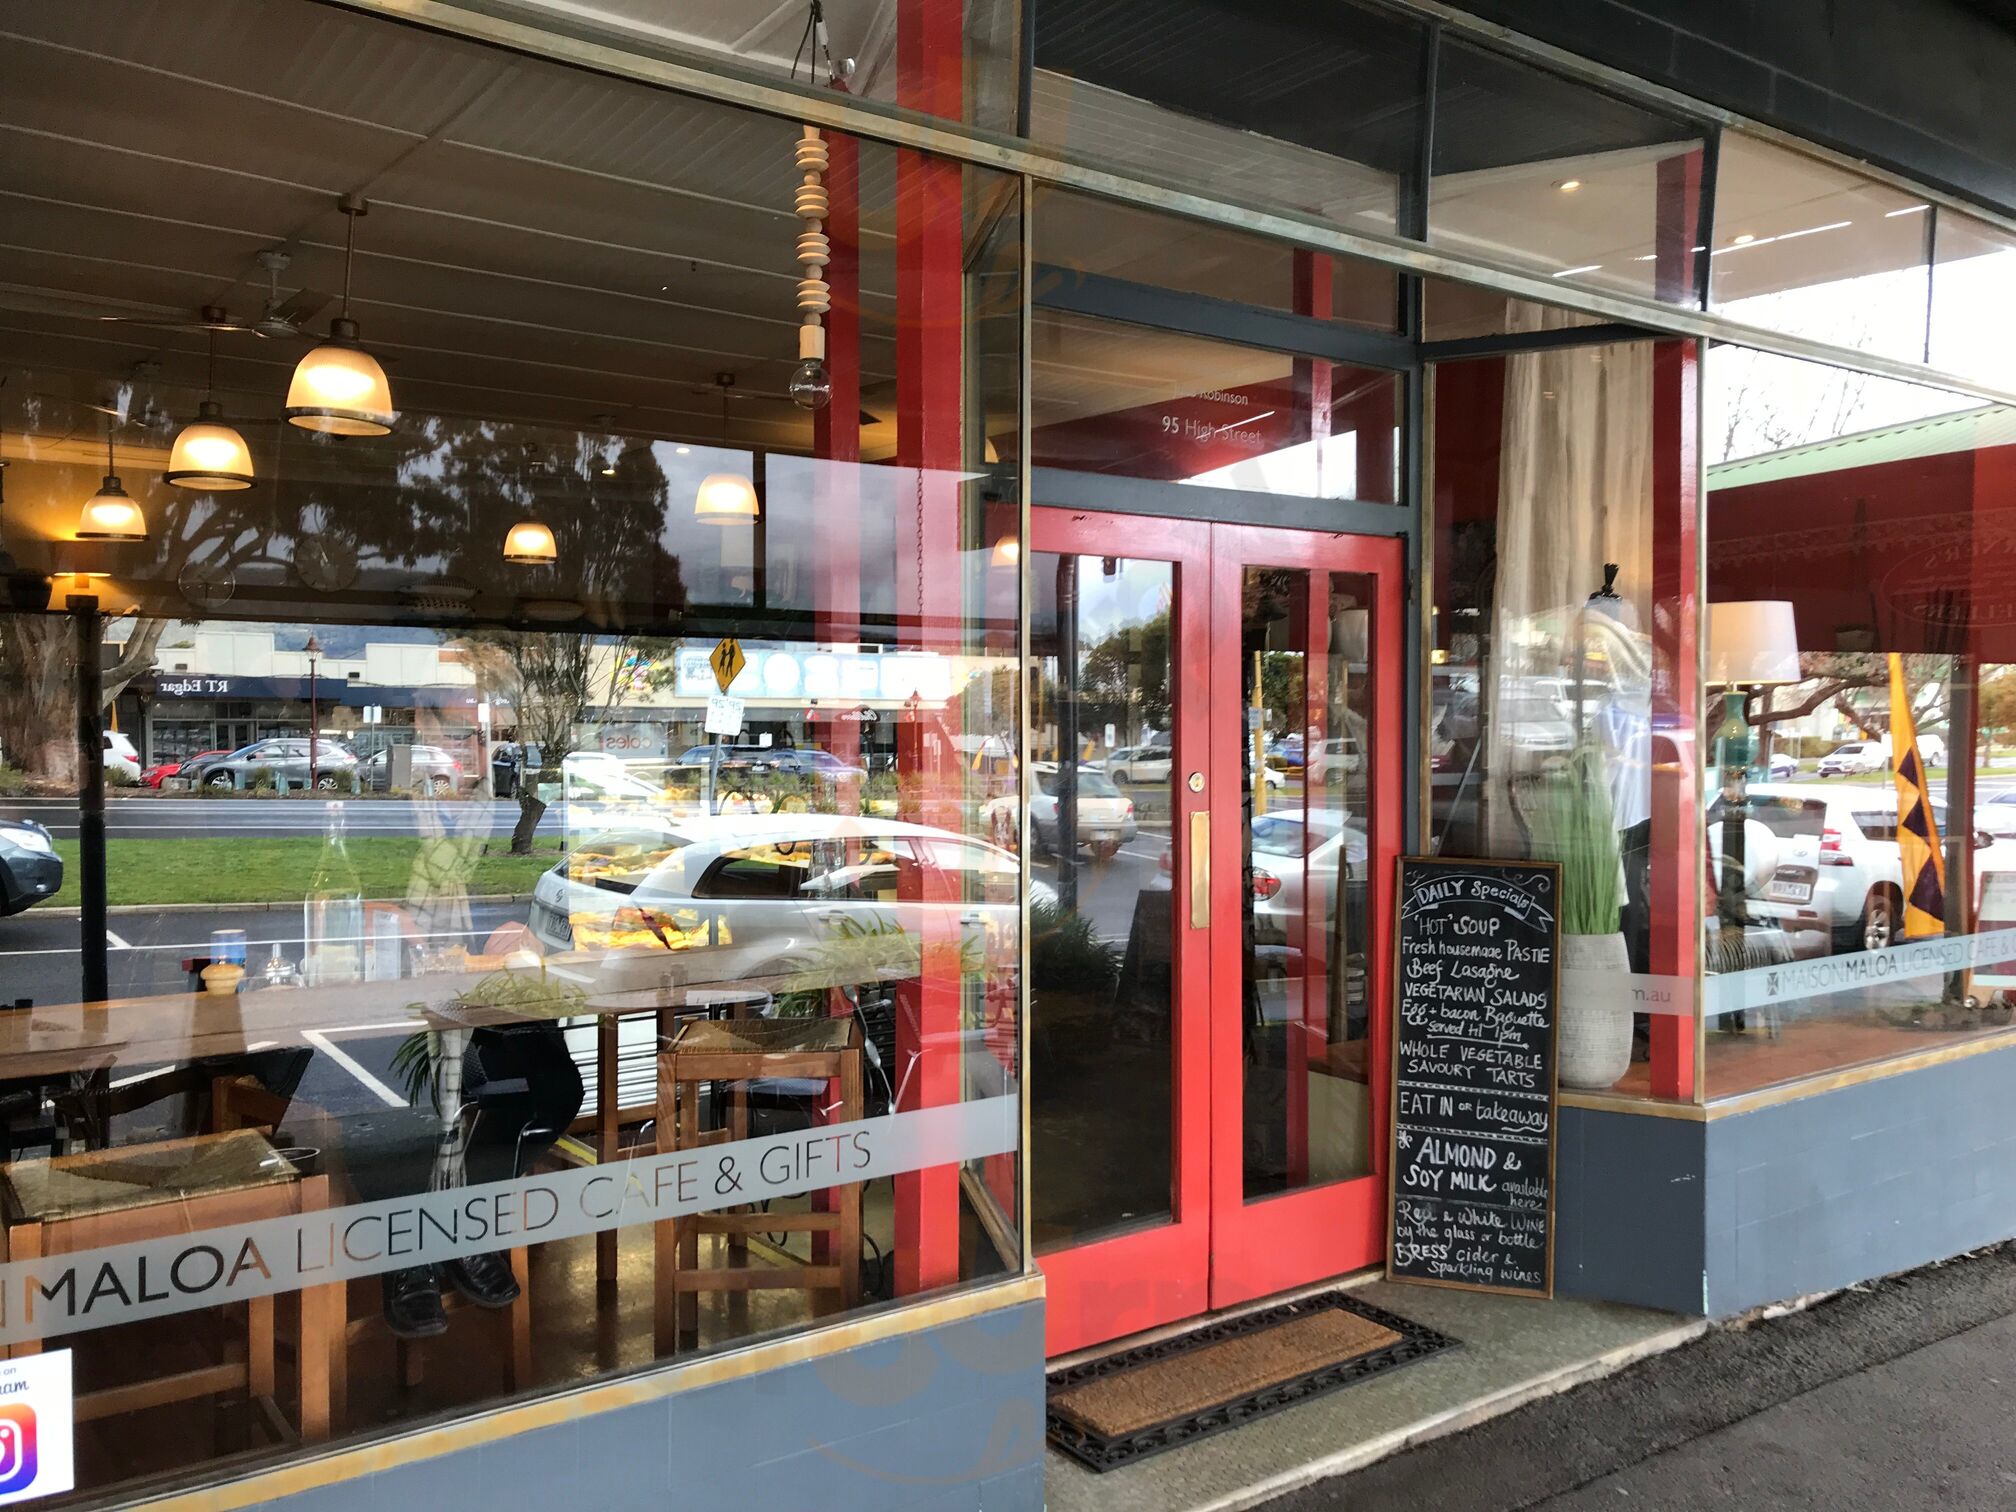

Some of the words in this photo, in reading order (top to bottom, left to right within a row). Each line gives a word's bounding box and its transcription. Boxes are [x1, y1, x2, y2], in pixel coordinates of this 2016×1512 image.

[1161, 415, 1180, 434] 95
[1184, 418, 1216, 442] High
[1221, 423, 1262, 444] Street
[1417, 879, 1465, 905] DAILY
[1470, 880, 1529, 909] Specials
[1453, 915, 1501, 937] SOUP
[1402, 936, 1437, 955] Fresh
[1503, 939, 1551, 964] PASTIE
[1902, 942, 1963, 973] LICENSED
[1967, 935, 1998, 961] CAFE
[2001, 936, 2010, 955] &
[1406, 957, 1444, 985] Beef
[1450, 960, 1520, 989] Lasagne
[1404, 982, 1486, 1004] VEGETARIAN
[1489, 988, 1548, 1010] SALADS
[1401, 999, 1429, 1026] Egg
[1440, 1002, 1482, 1021] bacon
[1482, 1005, 1550, 1032] Baguette
[1467, 1022, 1484, 1038] til
[1494, 1026, 1523, 1048] 1pm
[1399, 1039, 1451, 1059] WHOLE
[1459, 1044, 1543, 1070] VEGETABLE
[1407, 1058, 1476, 1080] SAVOURY
[1485, 1067, 1537, 1089] TARTS
[1400, 1091, 1436, 1115] EAT
[1439, 1096, 1454, 1117] IN
[1475, 1098, 1549, 1129] takeaway
[1415, 1135, 1497, 1170] ALMOND
[1502, 1151, 1523, 1171] &
[1402, 1164, 1444, 1192] SOY
[1449, 1171, 1497, 1193] MILK
[297, 1186, 559, 1273] LICENSED
[579, 1159, 699, 1219] CAFE
[715, 1155, 744, 1195] &
[760, 1130, 871, 1185] GIFTS
[1510, 1193, 1543, 1208] here
[1394, 1219, 1414, 1244] by
[1415, 1223, 1439, 1239] the
[1443, 1224, 1477, 1251] glass
[1480, 1233, 1493, 1243] or
[1498, 1230, 1544, 1250] bottle
[1510, 1212, 1546, 1234] WINE
[1394, 1241, 1449, 1267] BRESS
[1455, 1247, 1500, 1264] cider
[1500, 1265, 1542, 1284] wines
